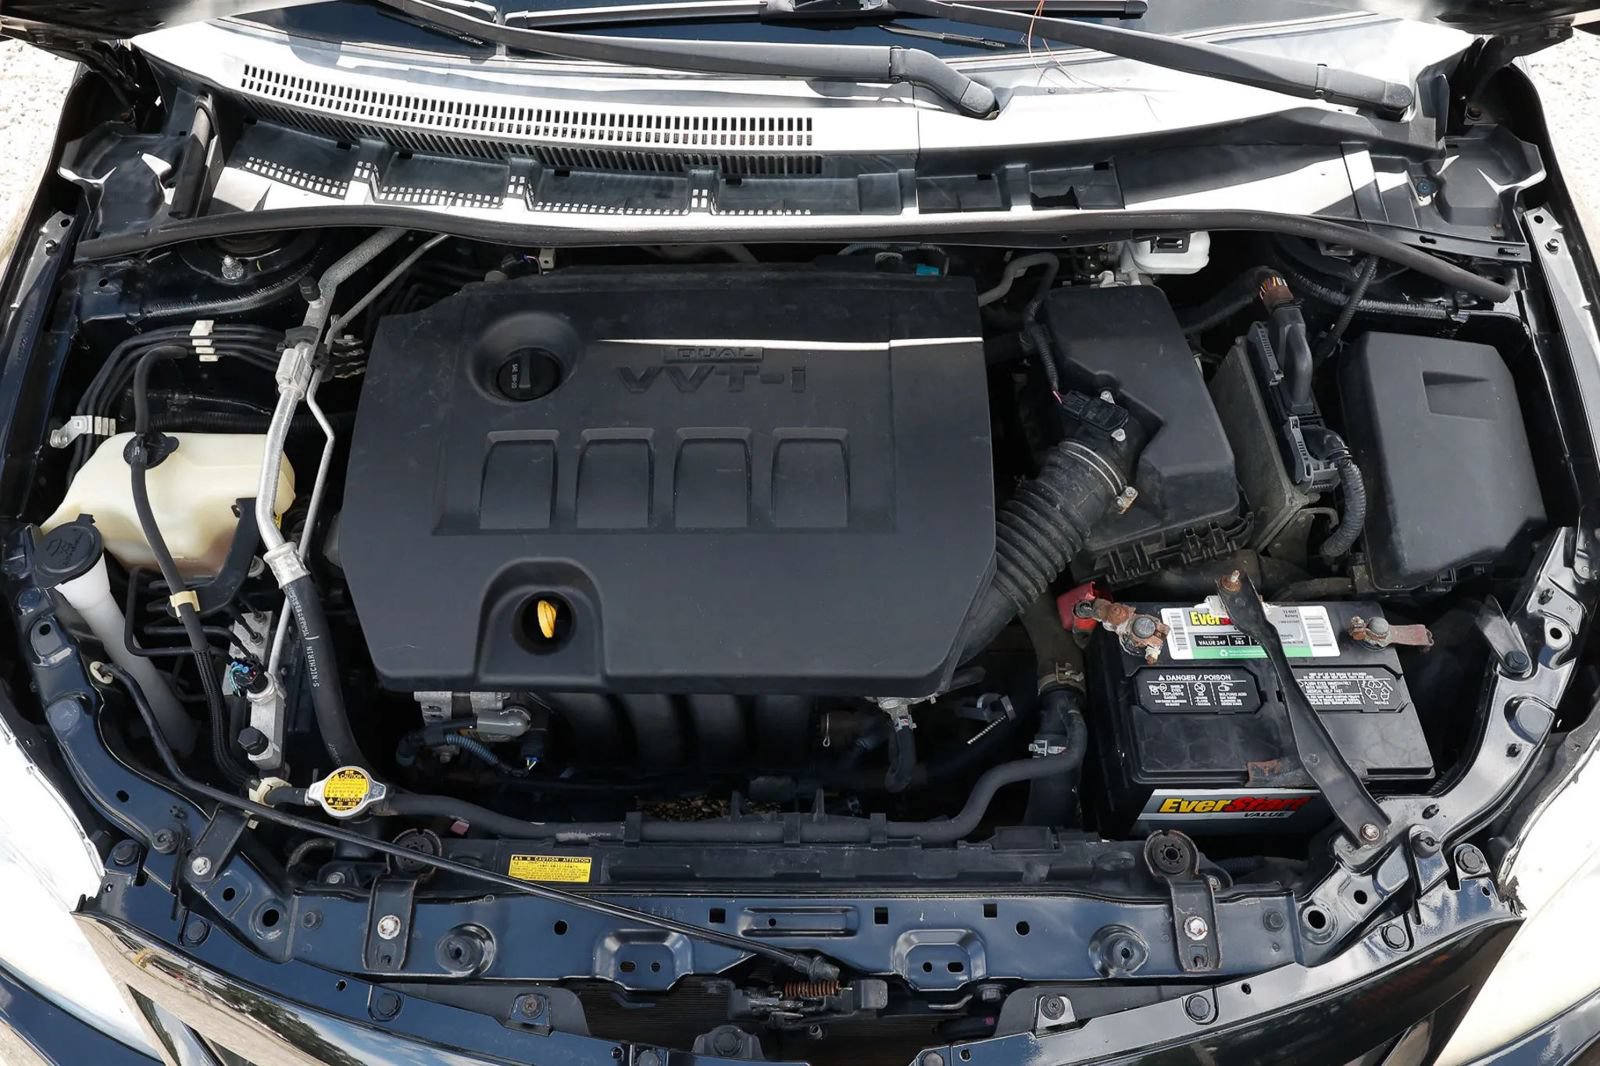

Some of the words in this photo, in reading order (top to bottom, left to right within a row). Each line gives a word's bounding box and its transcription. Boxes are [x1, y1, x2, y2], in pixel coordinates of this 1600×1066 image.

[676, 347, 756, 358] DUAL
[617, 366, 806, 394] VVT-i
[1159, 796, 1312, 813] EverStart
